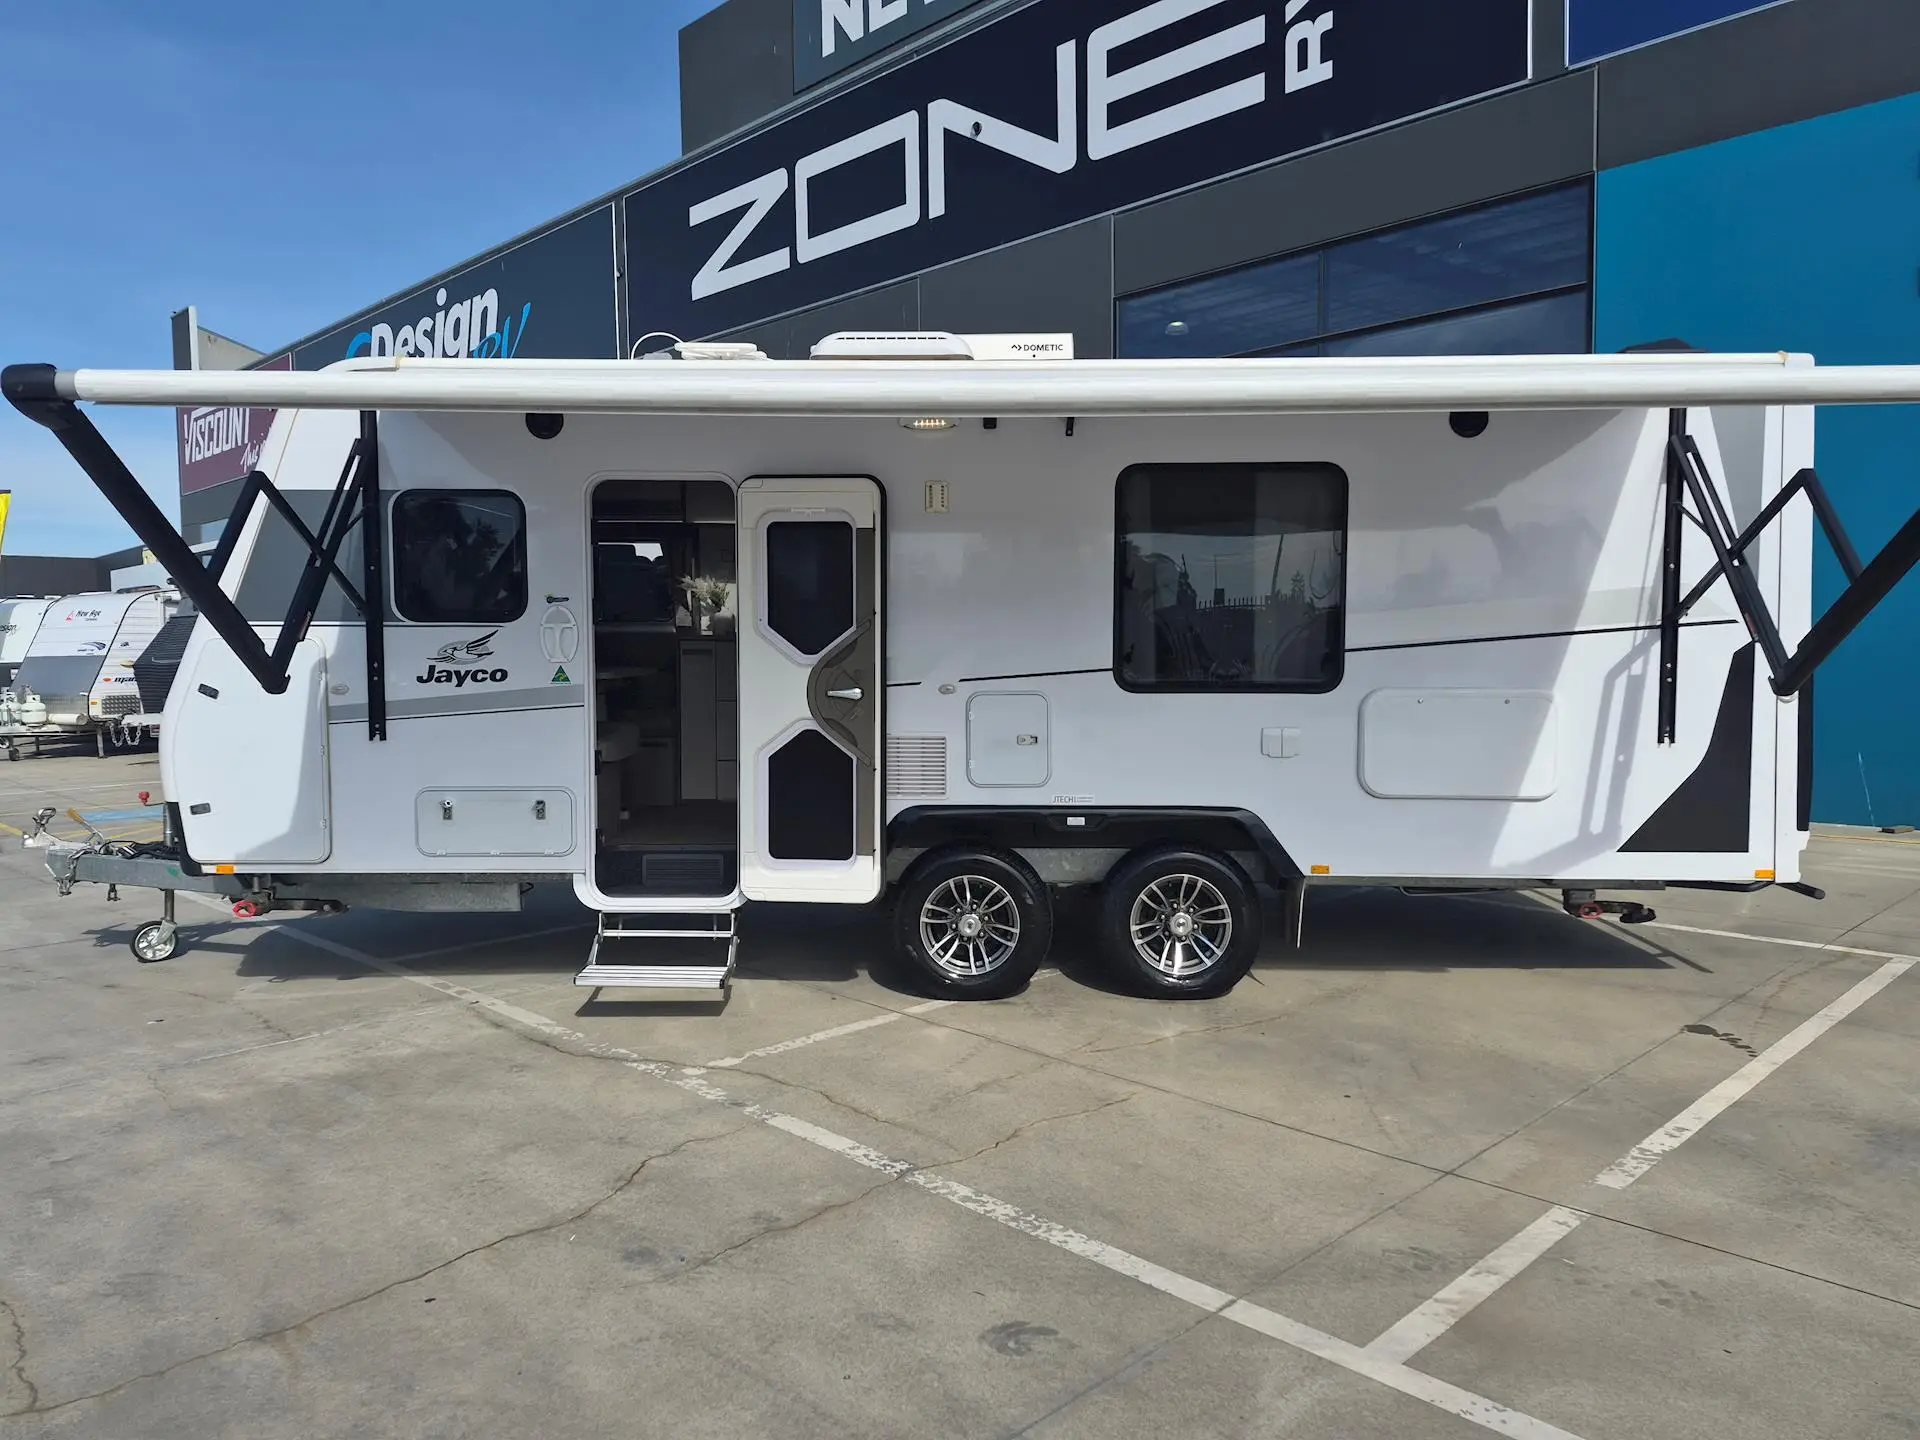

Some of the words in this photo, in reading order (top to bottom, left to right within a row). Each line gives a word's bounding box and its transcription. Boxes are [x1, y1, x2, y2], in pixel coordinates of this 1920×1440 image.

[689, 0, 1266, 301] ZONE
[1285, 0, 1334, 94] R
[371, 287, 498, 359] Design
[183, 407, 250, 465] VISCOUNT
[416, 664, 509, 688] Jayco
